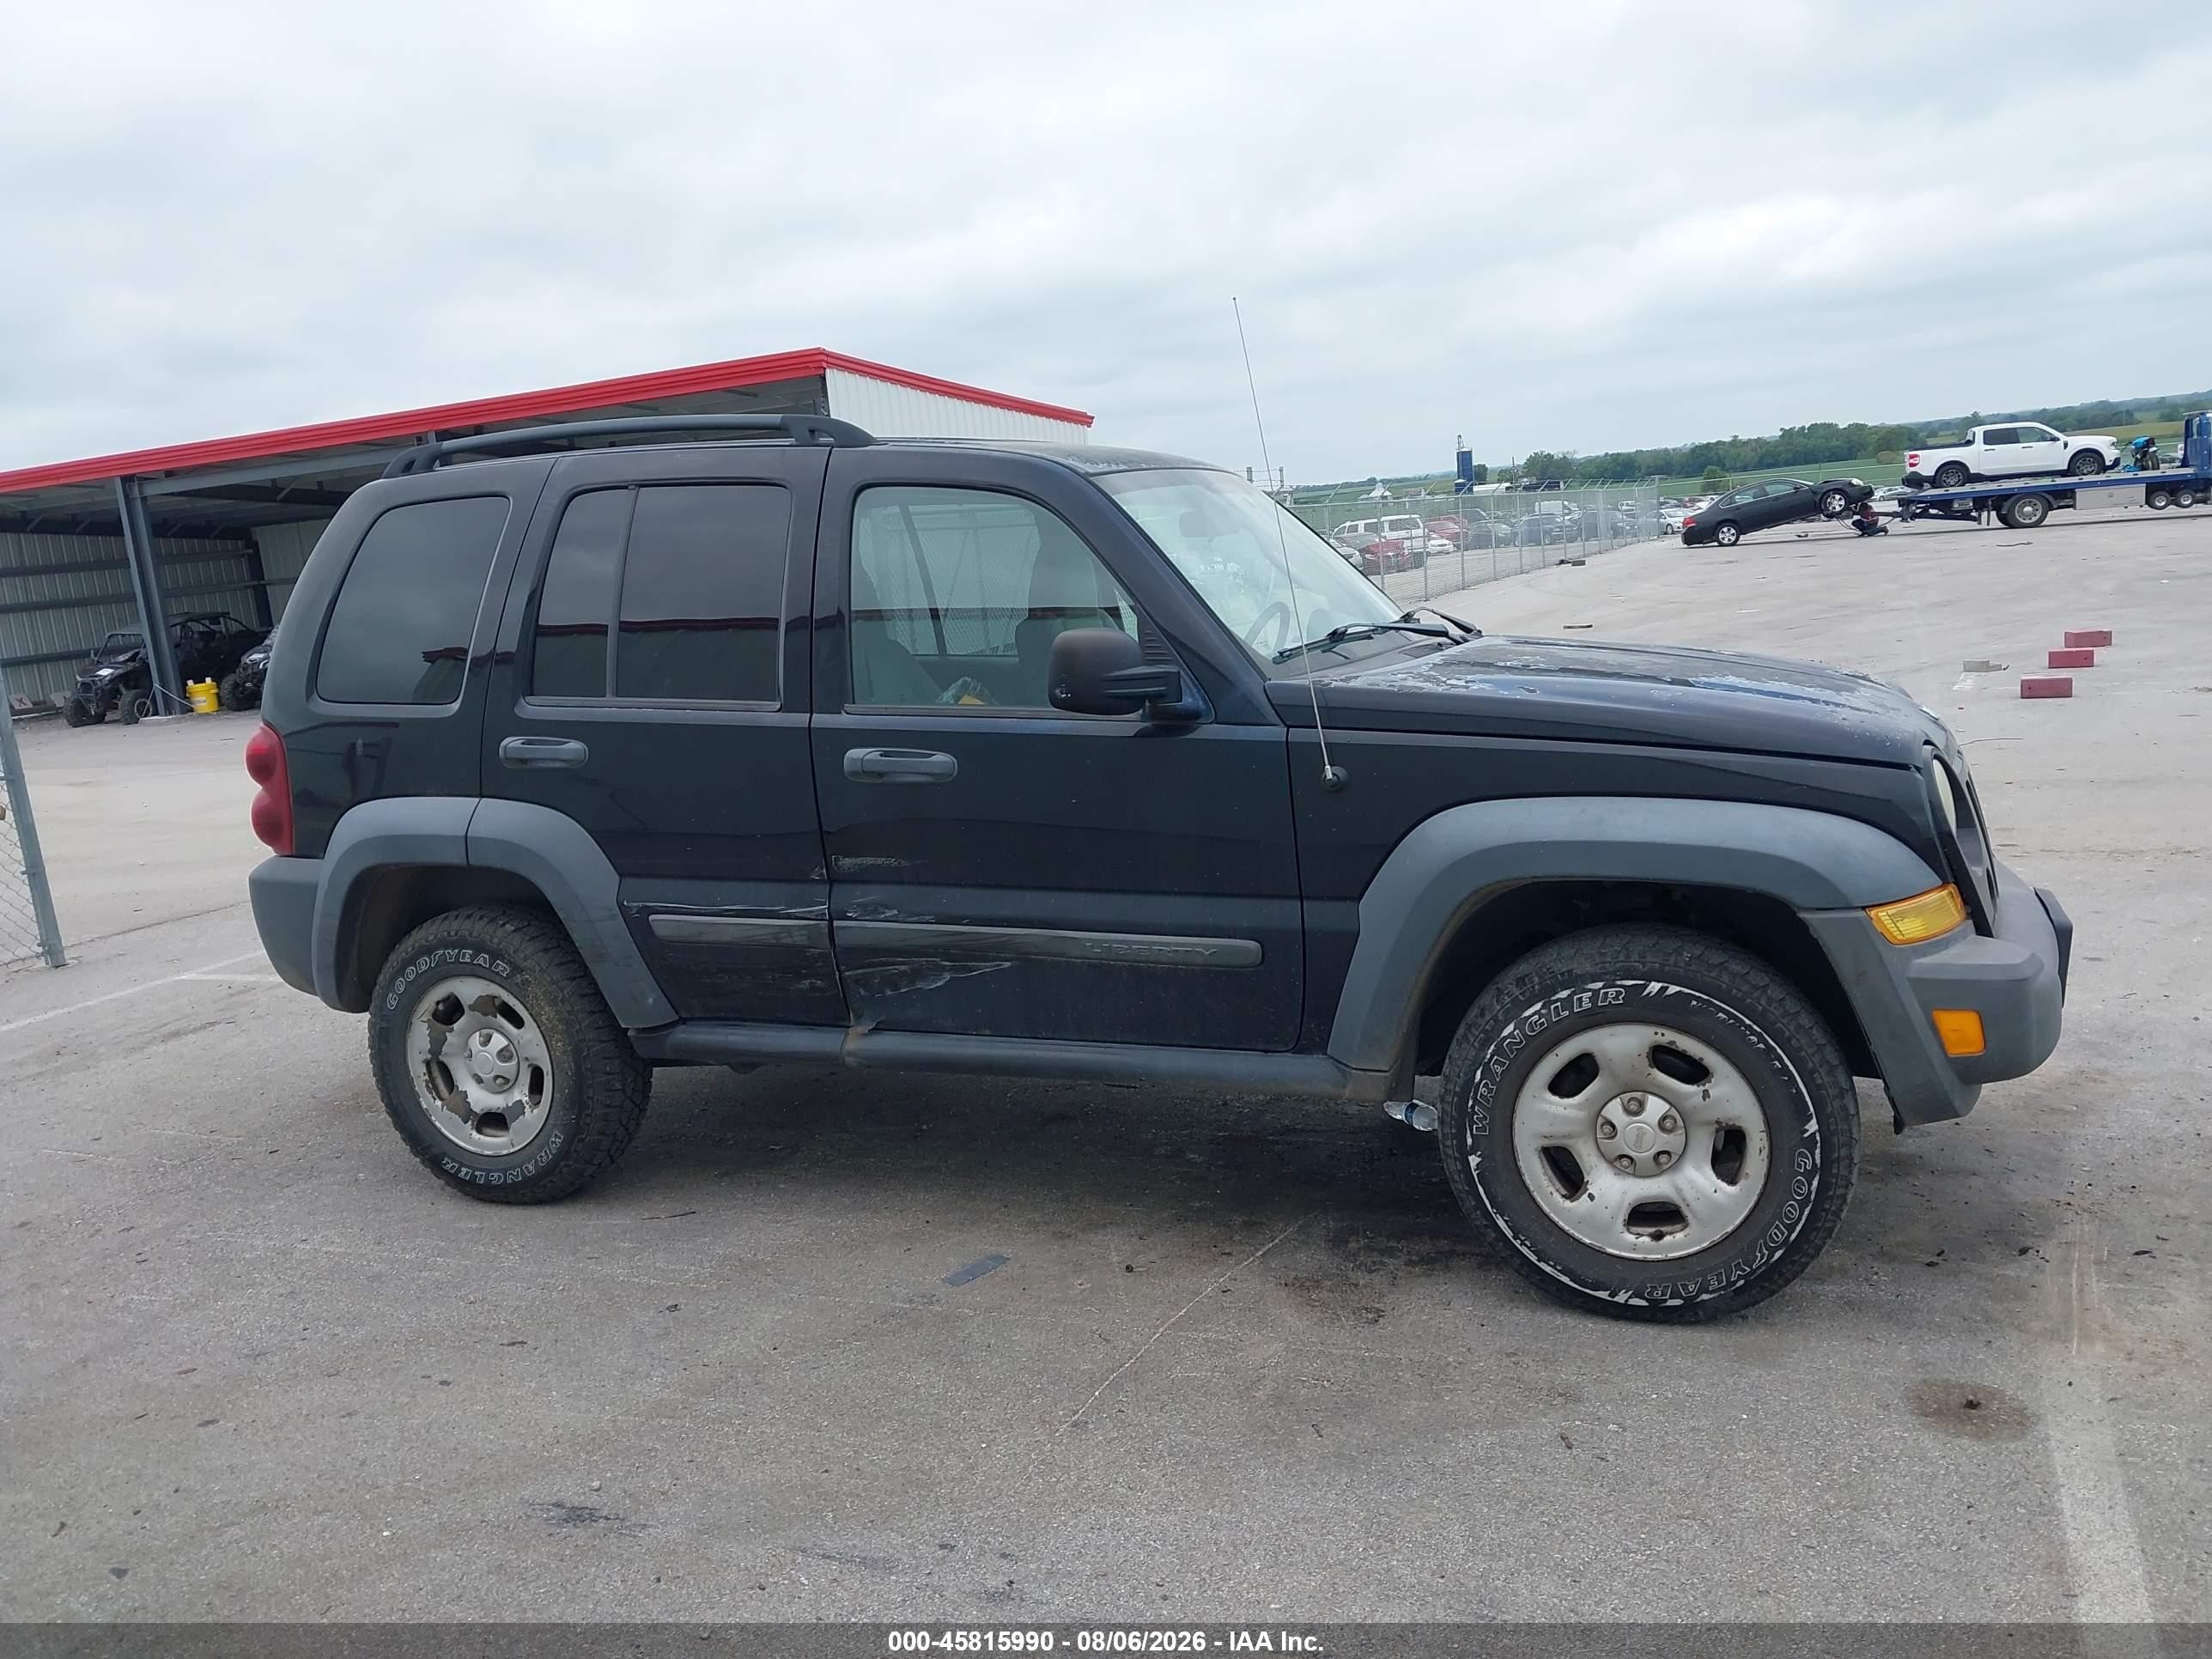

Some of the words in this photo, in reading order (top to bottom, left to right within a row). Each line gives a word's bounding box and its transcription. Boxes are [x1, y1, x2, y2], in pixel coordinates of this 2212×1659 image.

[386, 949, 510, 1010] GOODYEAR
[1473, 988, 1626, 1135] WRANGLER
[441, 1132, 564, 1185] WRANGLER
[1644, 1148, 1812, 1300] GOODYEAR
